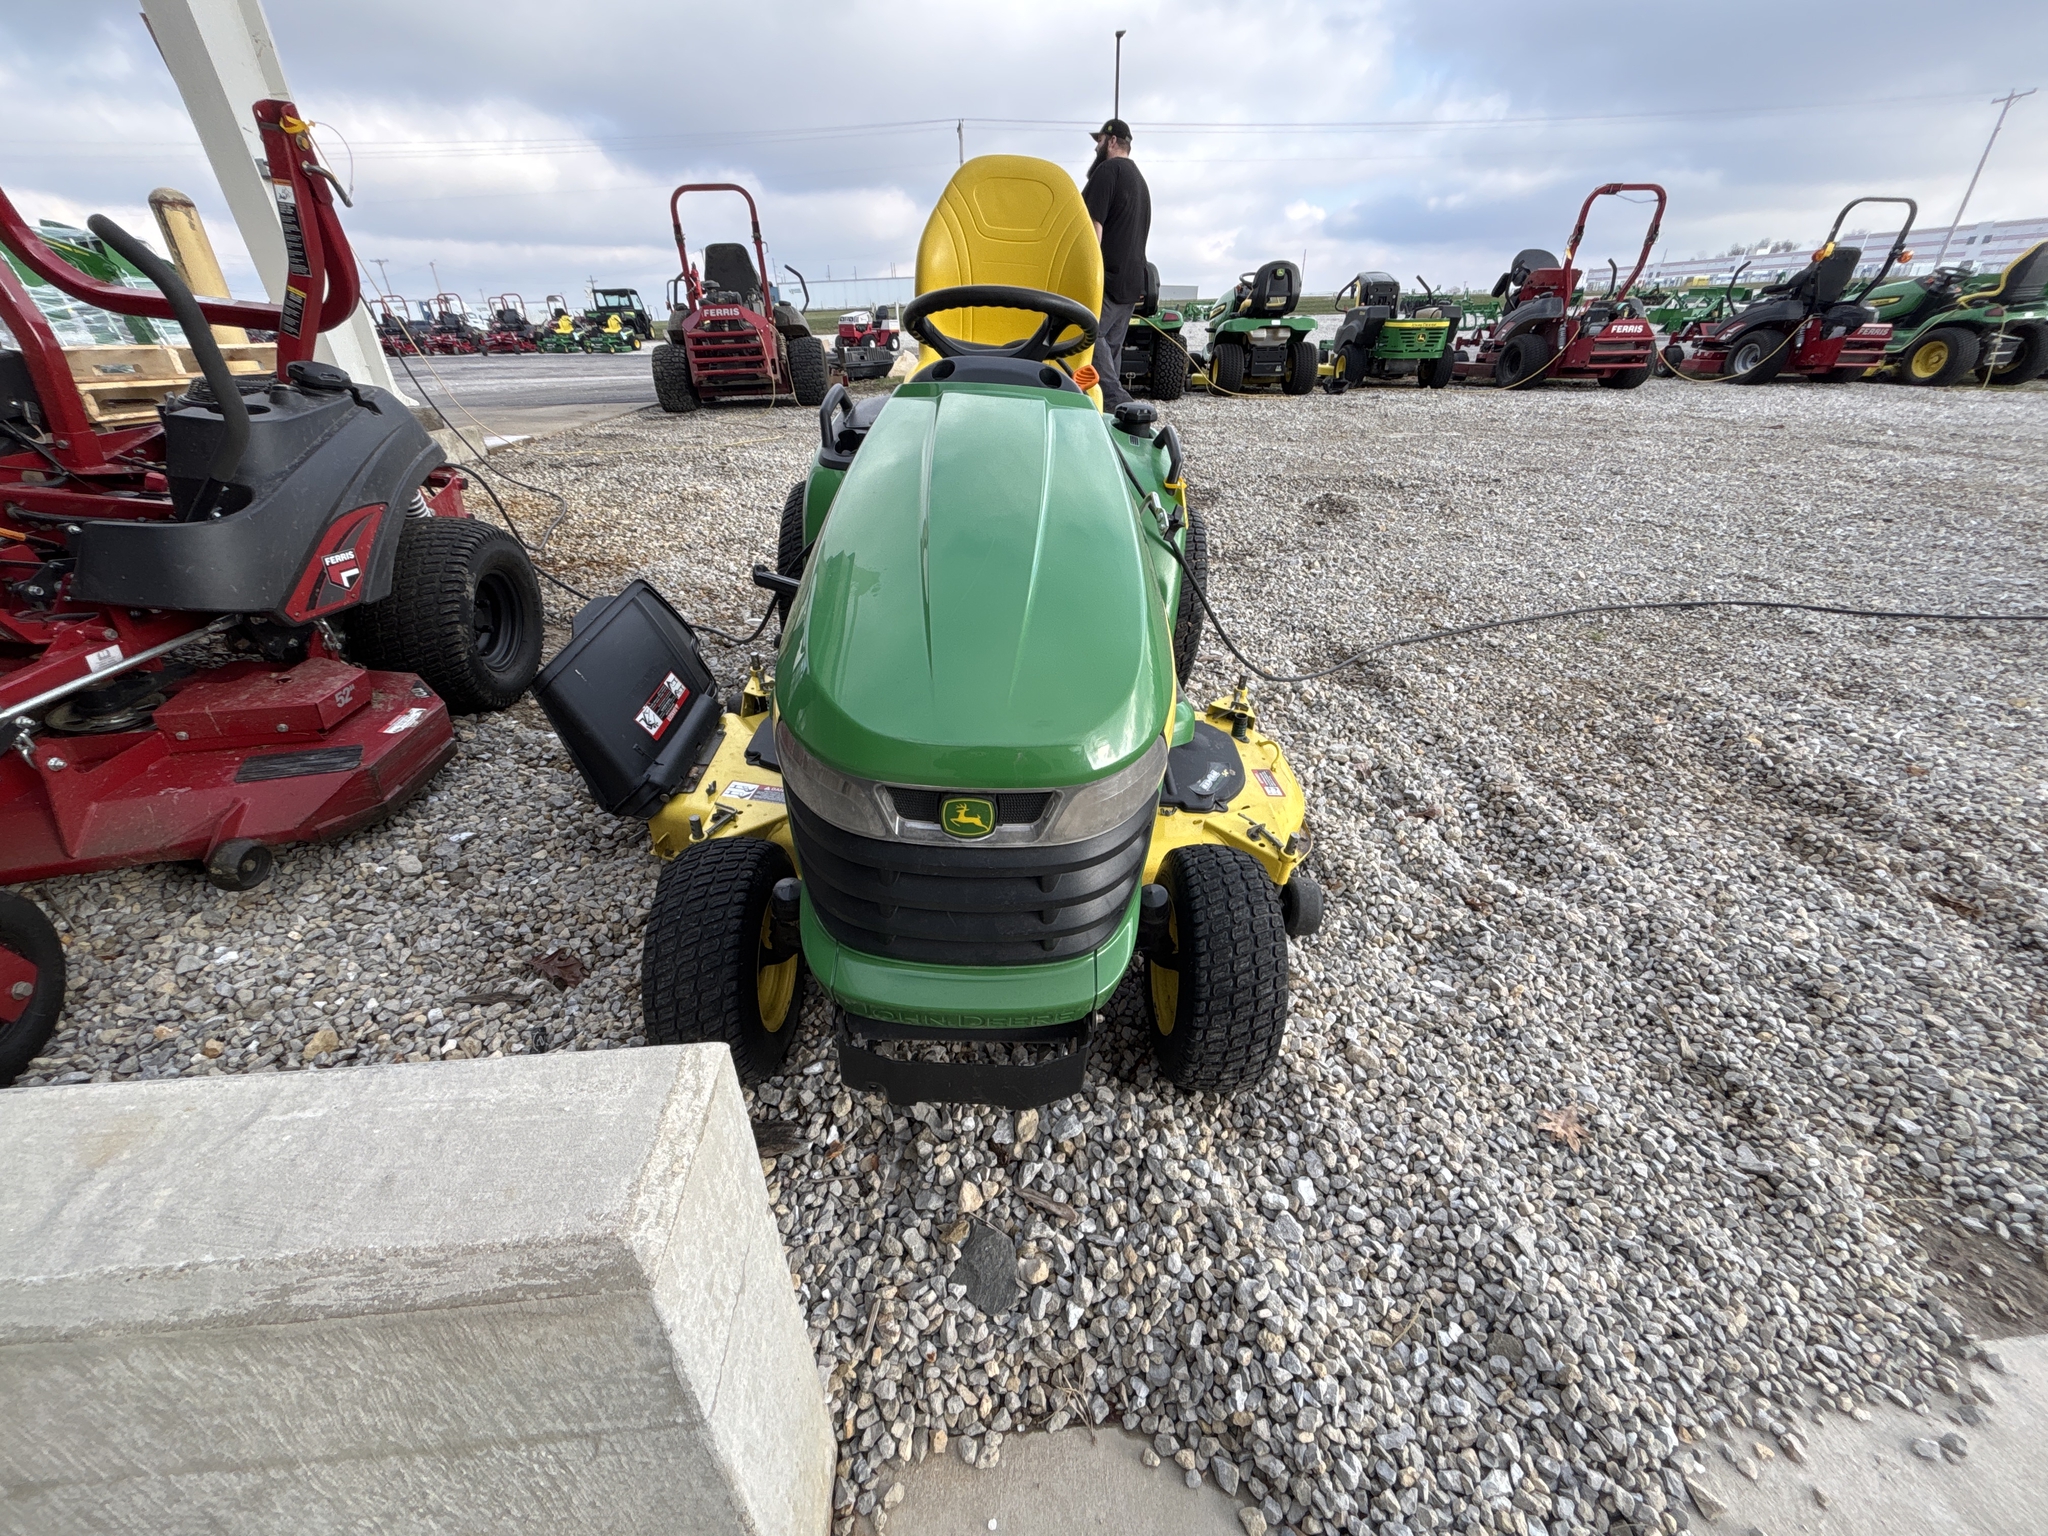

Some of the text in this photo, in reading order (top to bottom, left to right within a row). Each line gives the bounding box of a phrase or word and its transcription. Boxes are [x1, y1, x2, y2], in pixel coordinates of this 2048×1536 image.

[703, 307, 740, 317] FERRIS
[1610, 324, 1644, 334] FERRIS
[1857, 327, 1890, 336] FERRIS
[324, 550, 355, 566] FERRIS
[958, 1011, 1077, 1029] DEERE
